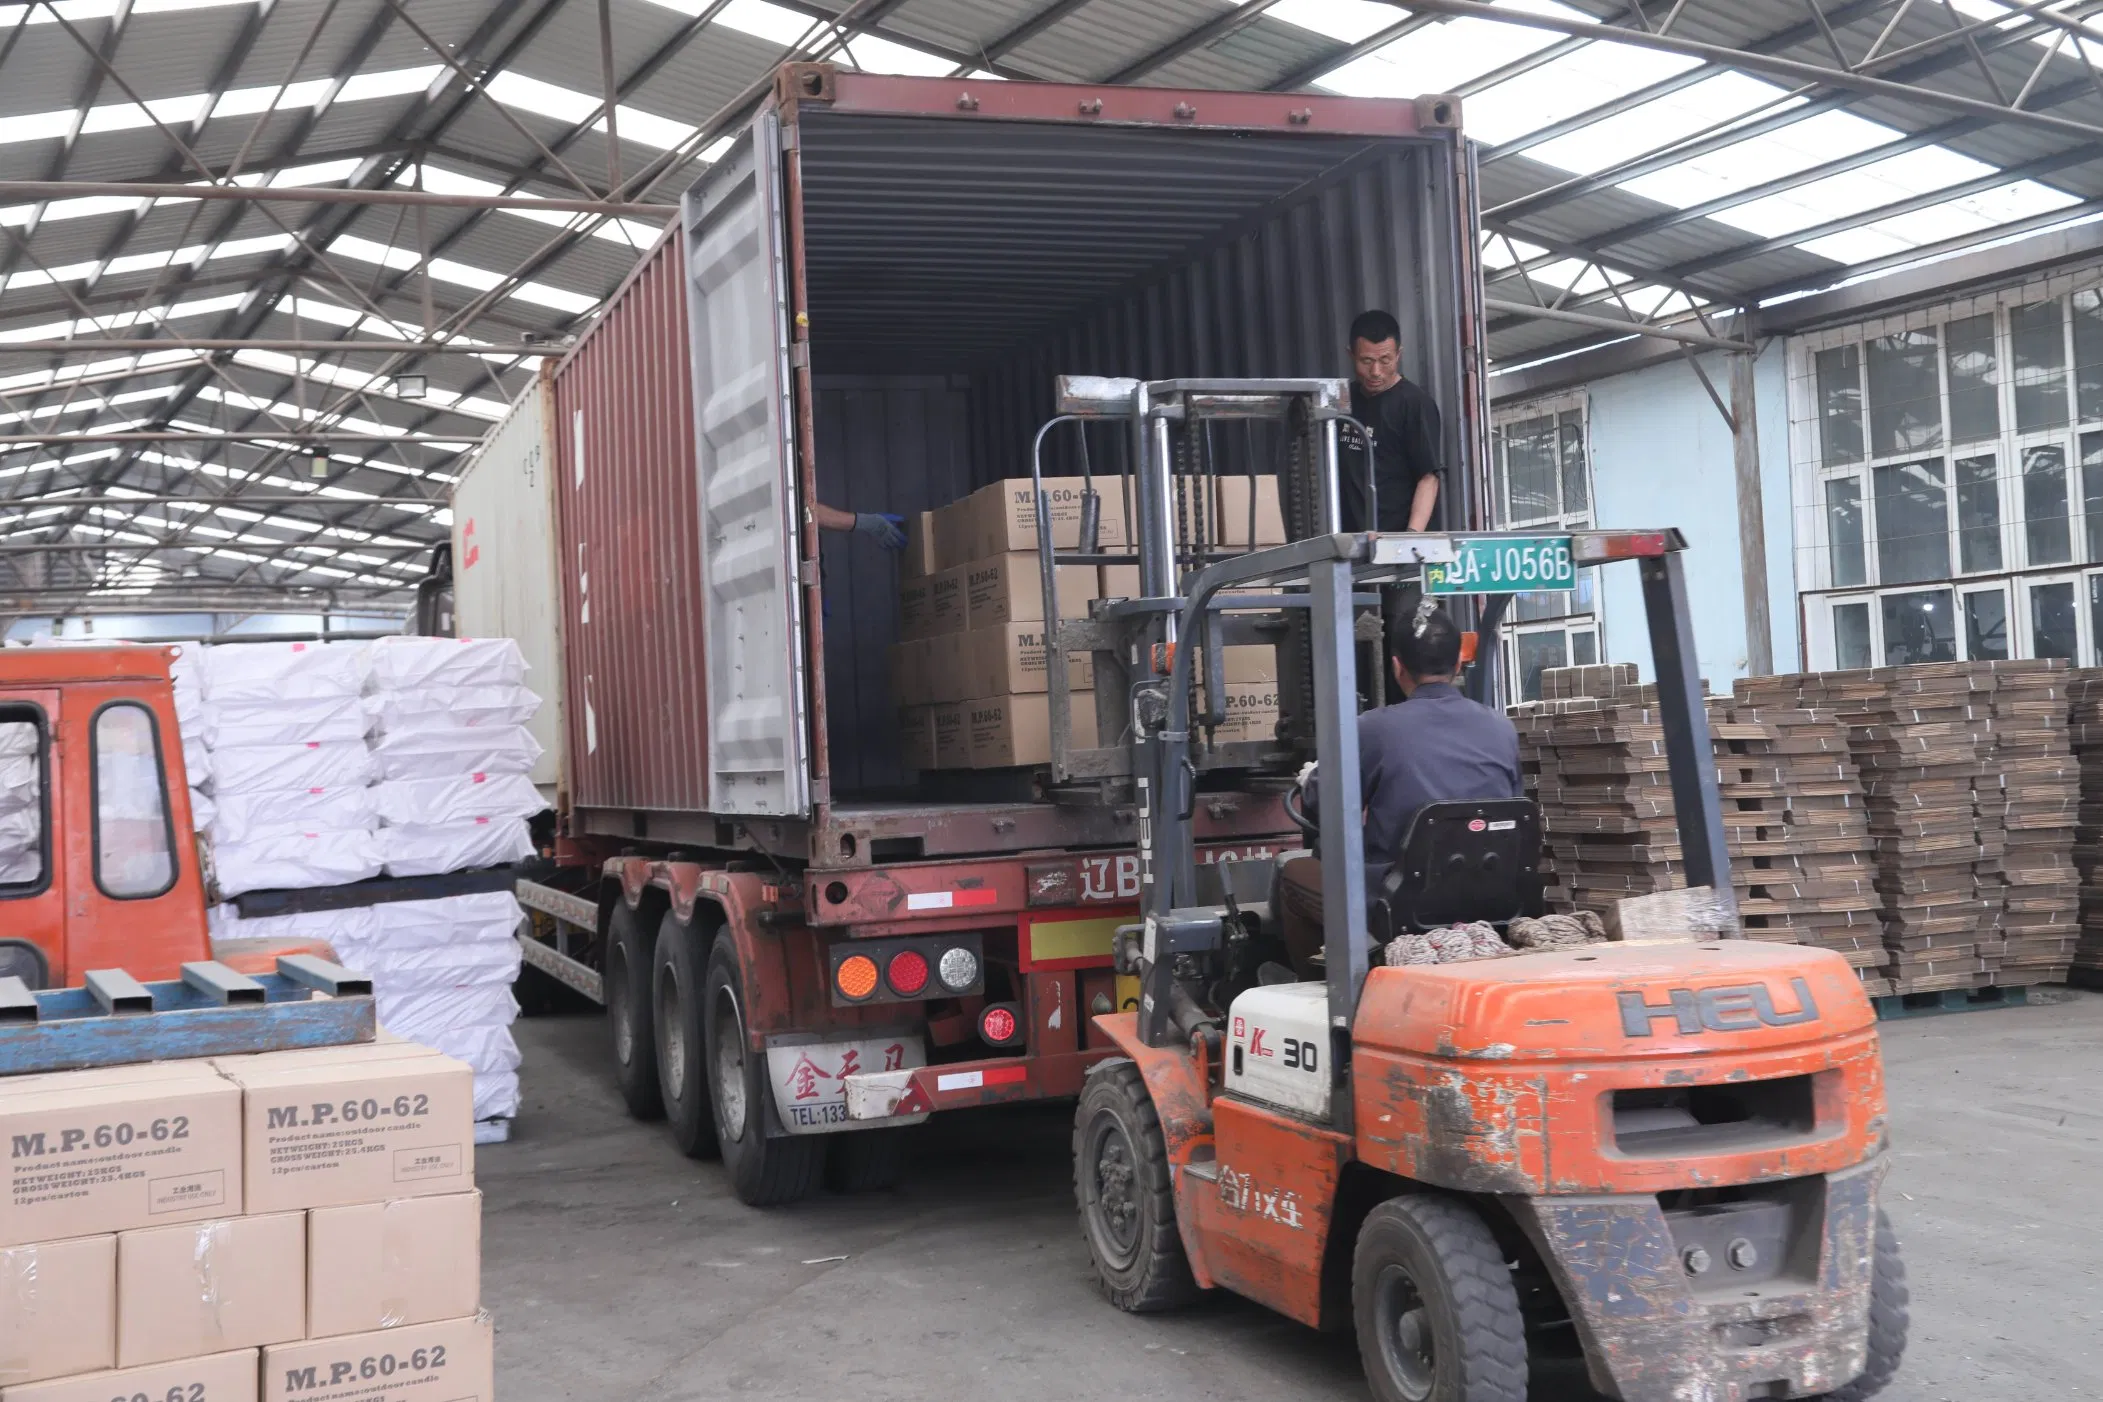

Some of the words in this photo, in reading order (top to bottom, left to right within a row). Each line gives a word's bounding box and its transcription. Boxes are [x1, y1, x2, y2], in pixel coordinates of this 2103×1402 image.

[1284, 1038, 1317, 1073] 30
[267, 1094, 429, 1129] M.P.60-62
[11, 1116, 189, 1158] M.P.60-62
[285, 1345, 446, 1392] M.P.60-62
